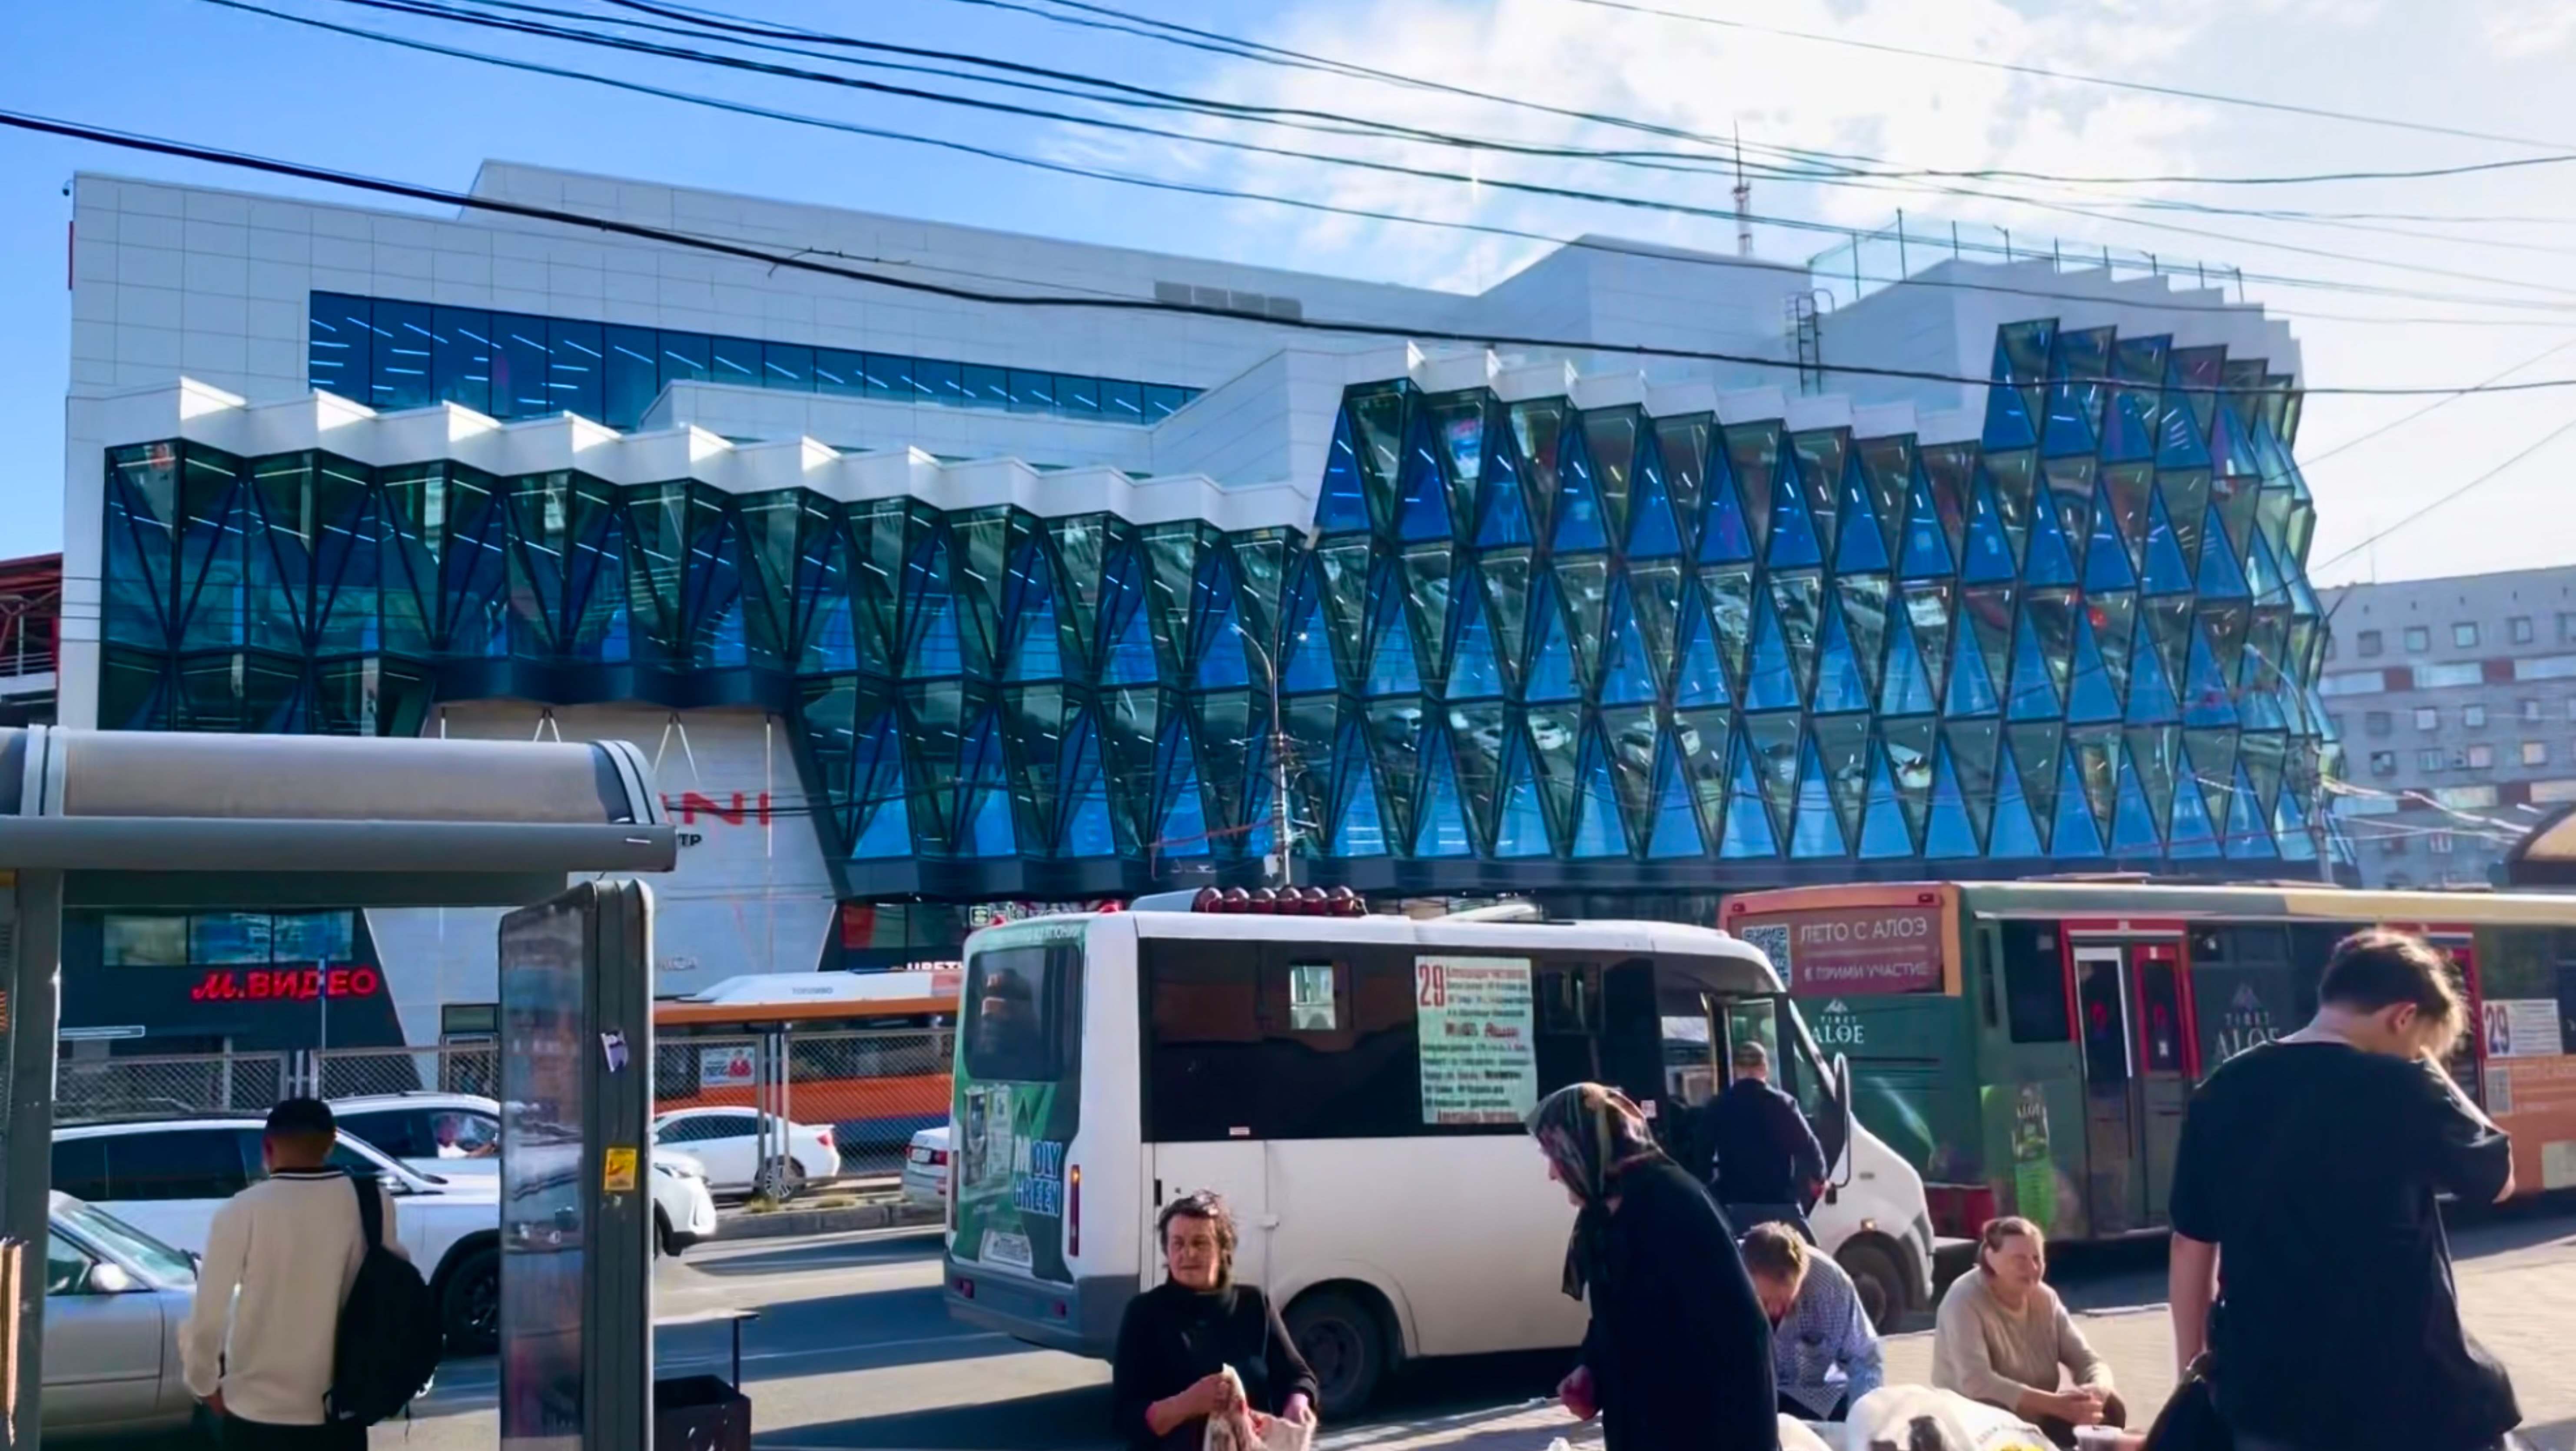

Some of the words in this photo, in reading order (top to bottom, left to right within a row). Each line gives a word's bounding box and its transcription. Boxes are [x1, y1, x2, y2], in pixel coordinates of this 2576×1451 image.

[1801, 922, 1849, 944] ЛЕТО
[1854, 920, 1868, 940] С
[1871, 916, 1928, 940] АЛОЭ
[190, 967, 378, 1000] М.ВИДЕО
[1418, 963, 1445, 1007] 29
[1811, 1025, 1866, 1044] ALOE
[2485, 1003, 2510, 1055] 29
[1014, 1133, 1063, 1179] MOLY
[1013, 1175, 1062, 1218] GREEN
